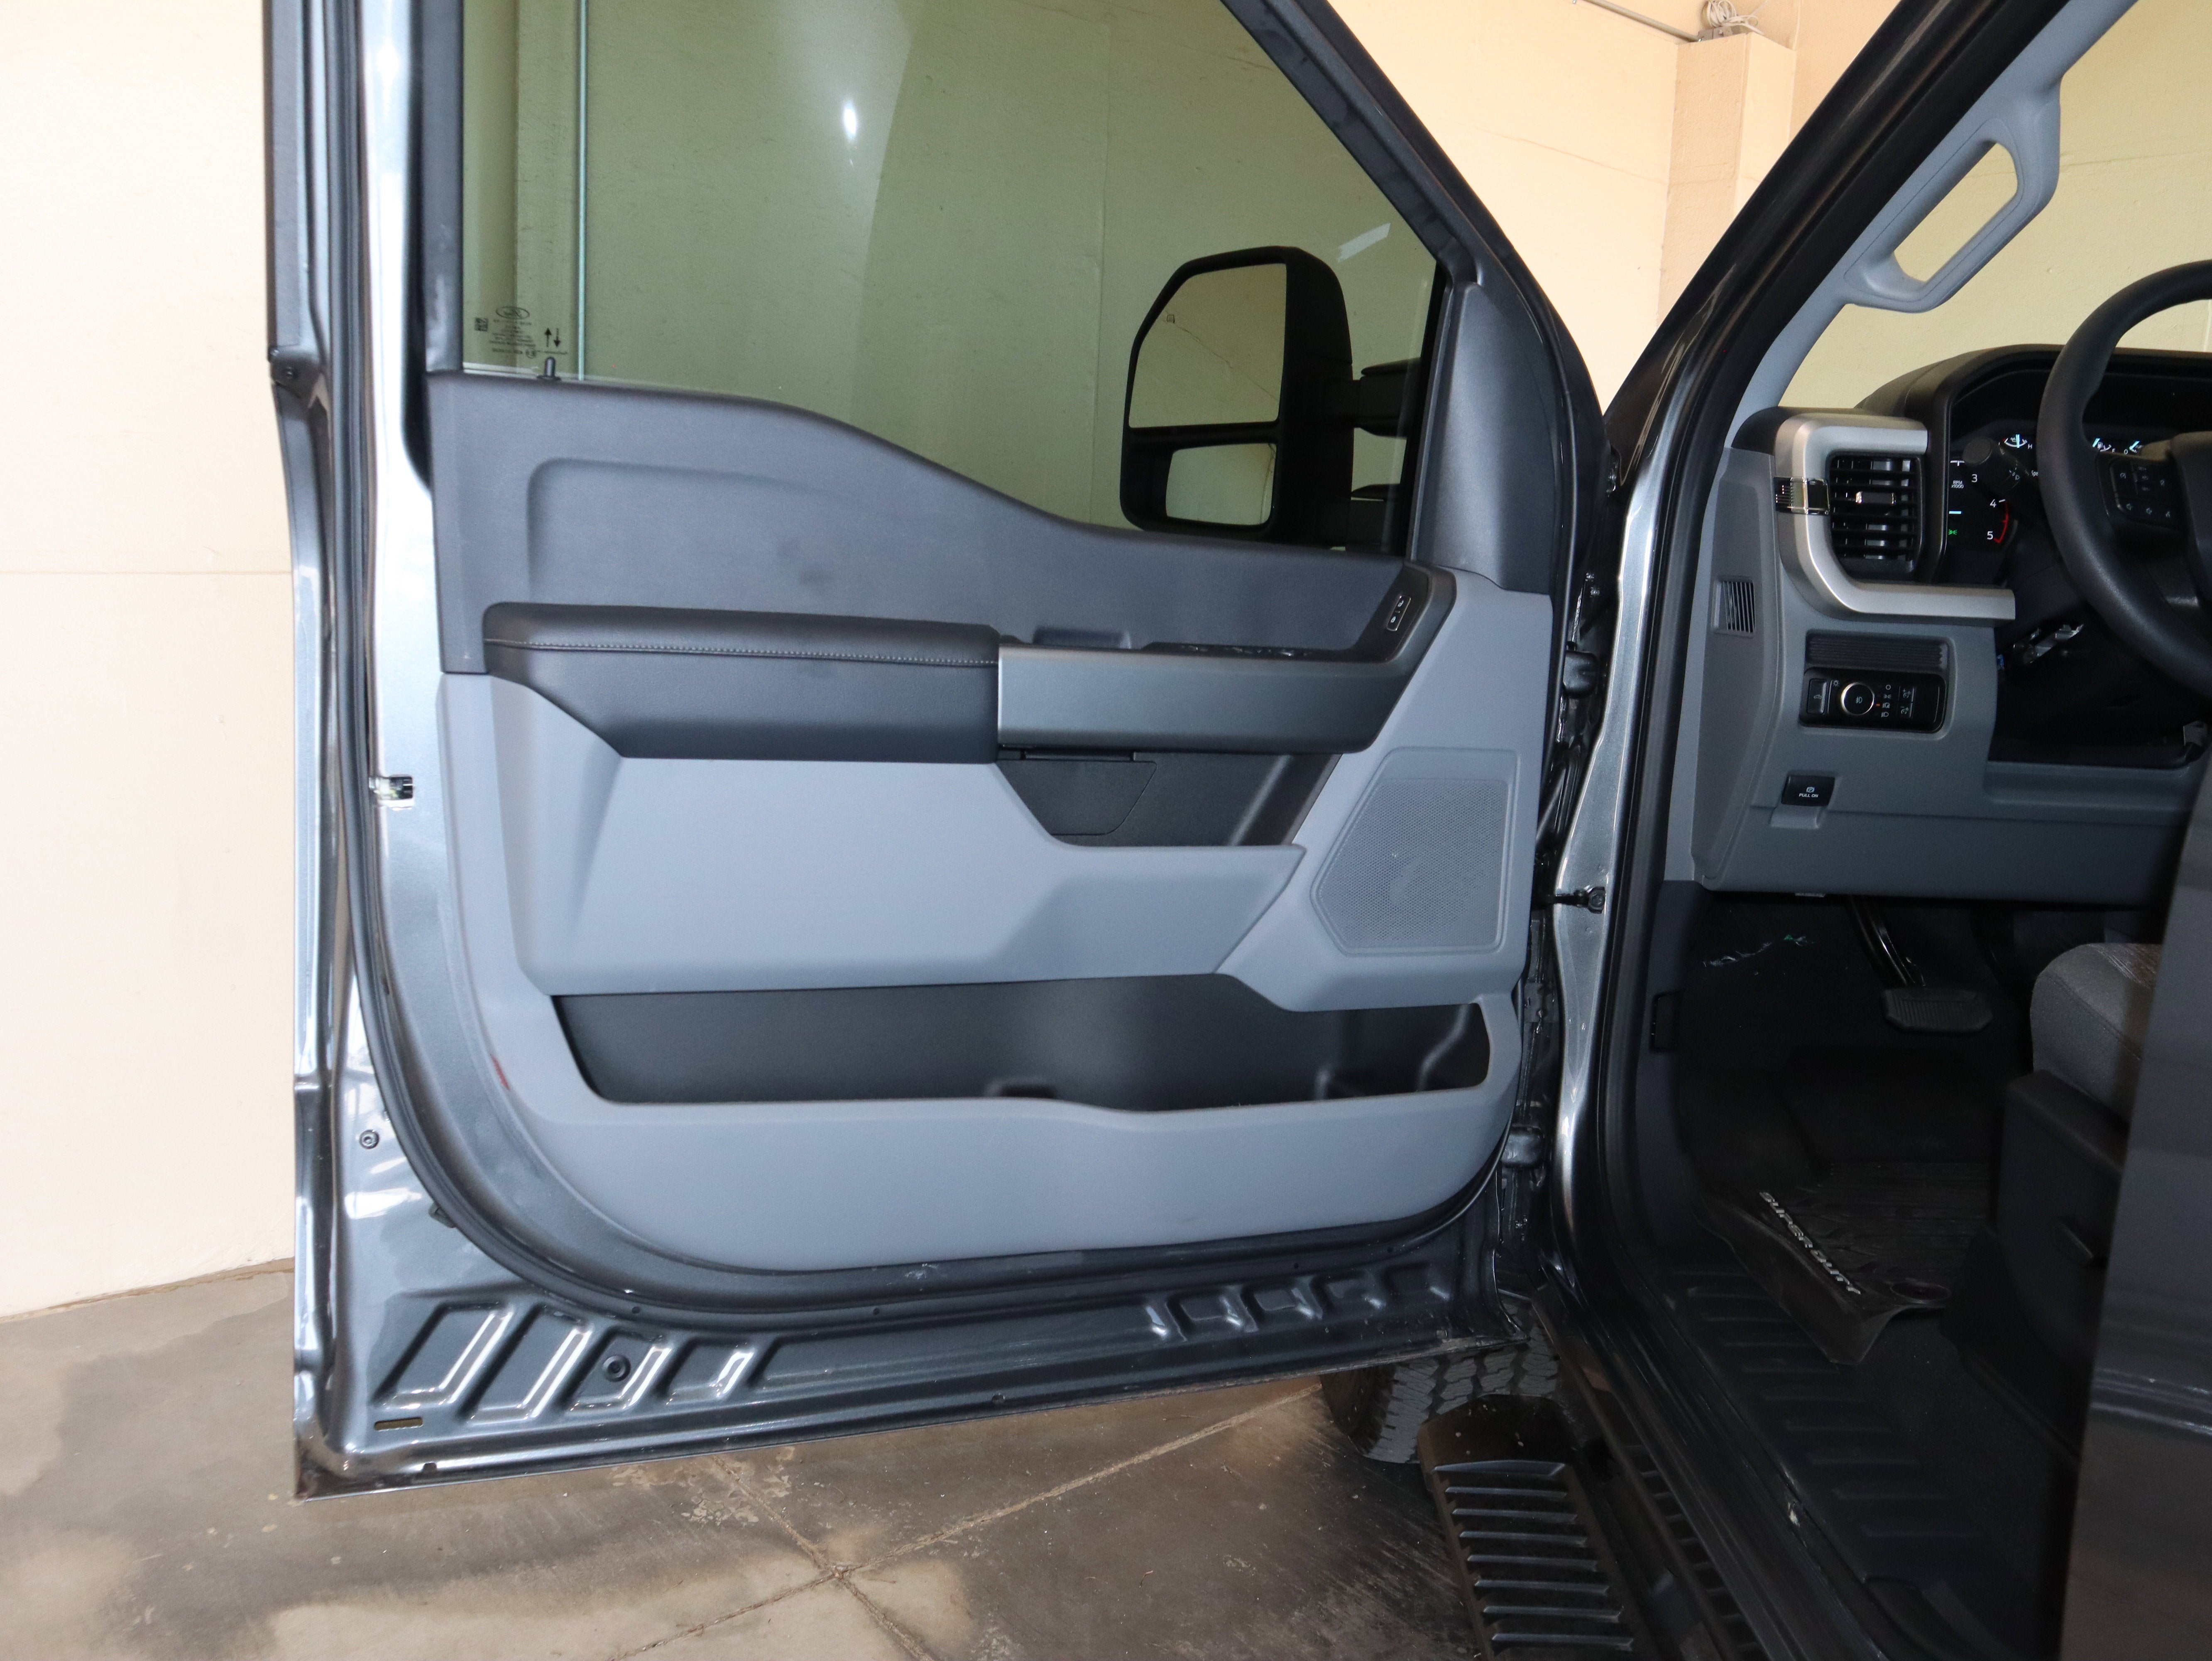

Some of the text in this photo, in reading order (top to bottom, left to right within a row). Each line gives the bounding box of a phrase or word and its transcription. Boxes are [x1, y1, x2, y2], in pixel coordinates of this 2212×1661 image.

[1971, 474, 1978, 483] 3
[1989, 499, 1997, 507] 4
[1987, 531, 1994, 540] 5
[1759, 1191, 1861, 1295] SUPER DUTY
